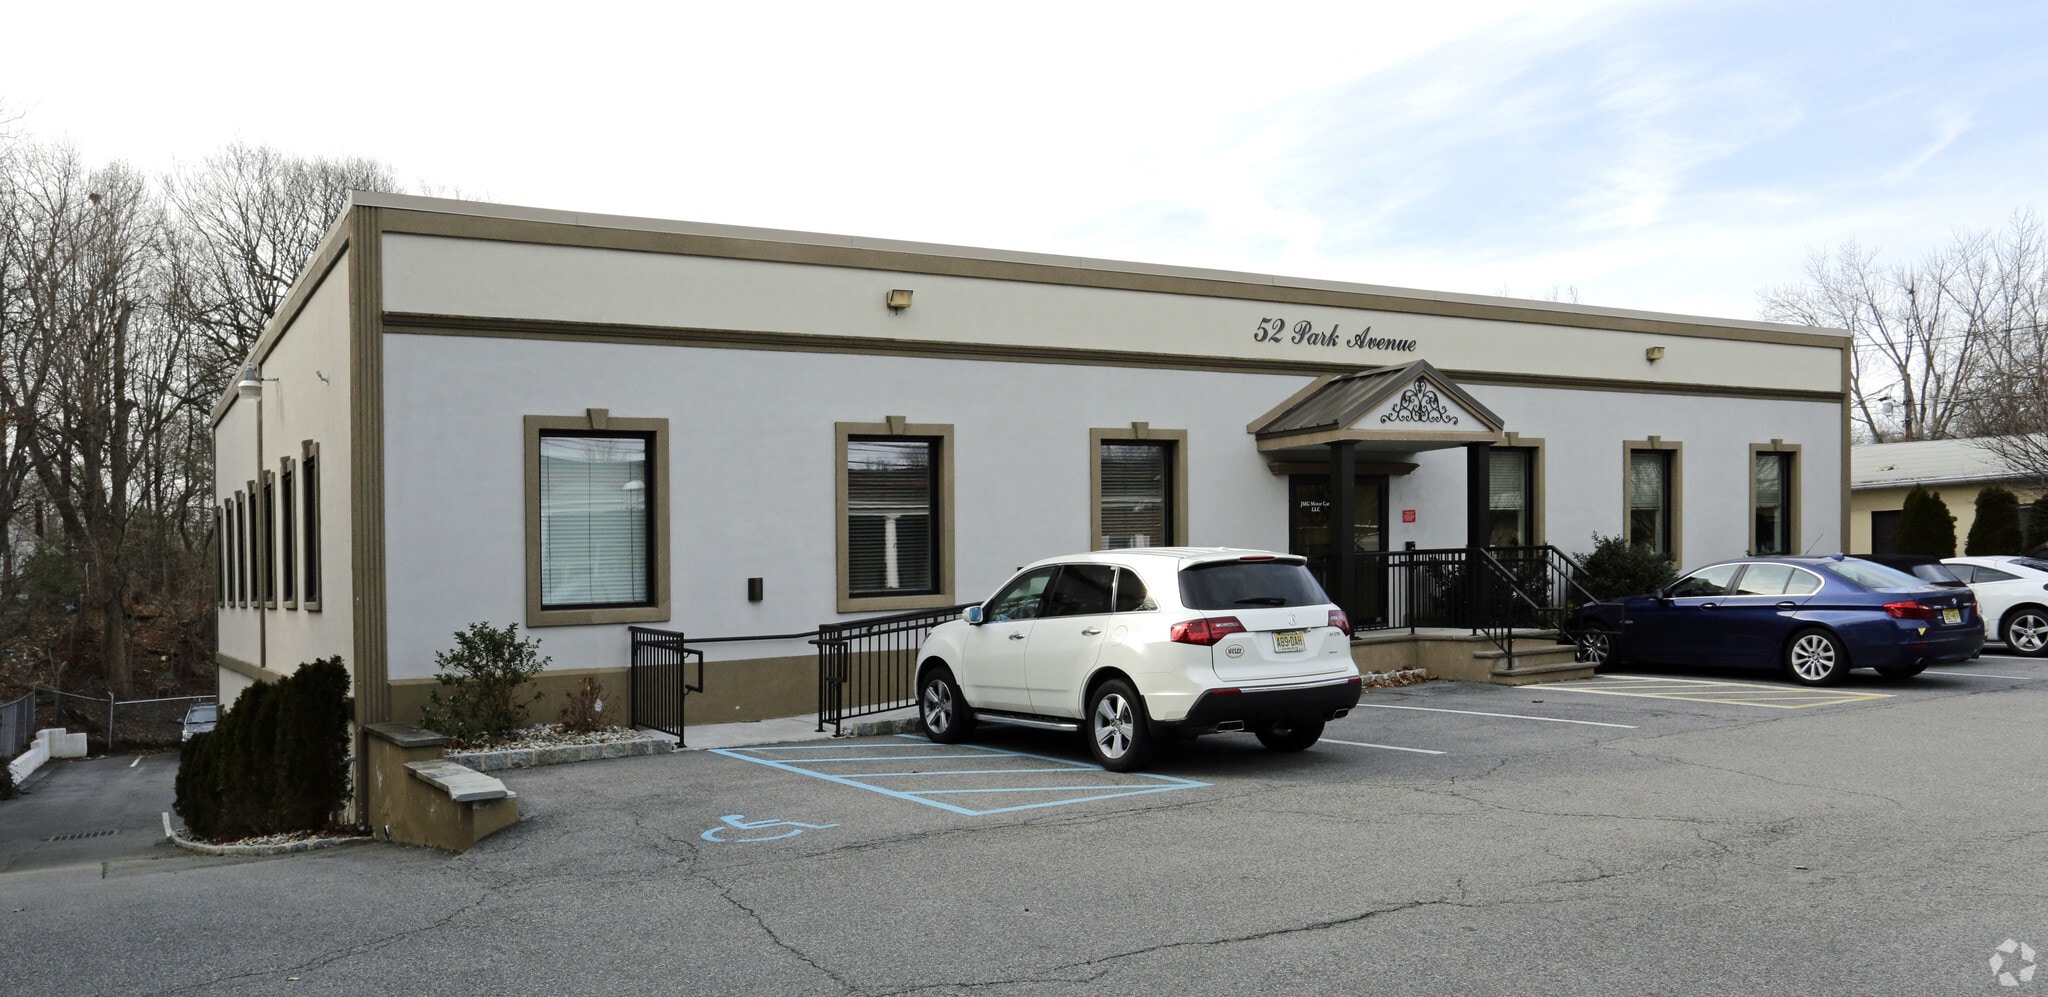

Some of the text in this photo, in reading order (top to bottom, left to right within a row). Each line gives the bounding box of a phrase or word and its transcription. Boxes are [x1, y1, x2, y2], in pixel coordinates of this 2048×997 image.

[1253, 317, 1417, 352] 52 Park Avenue
